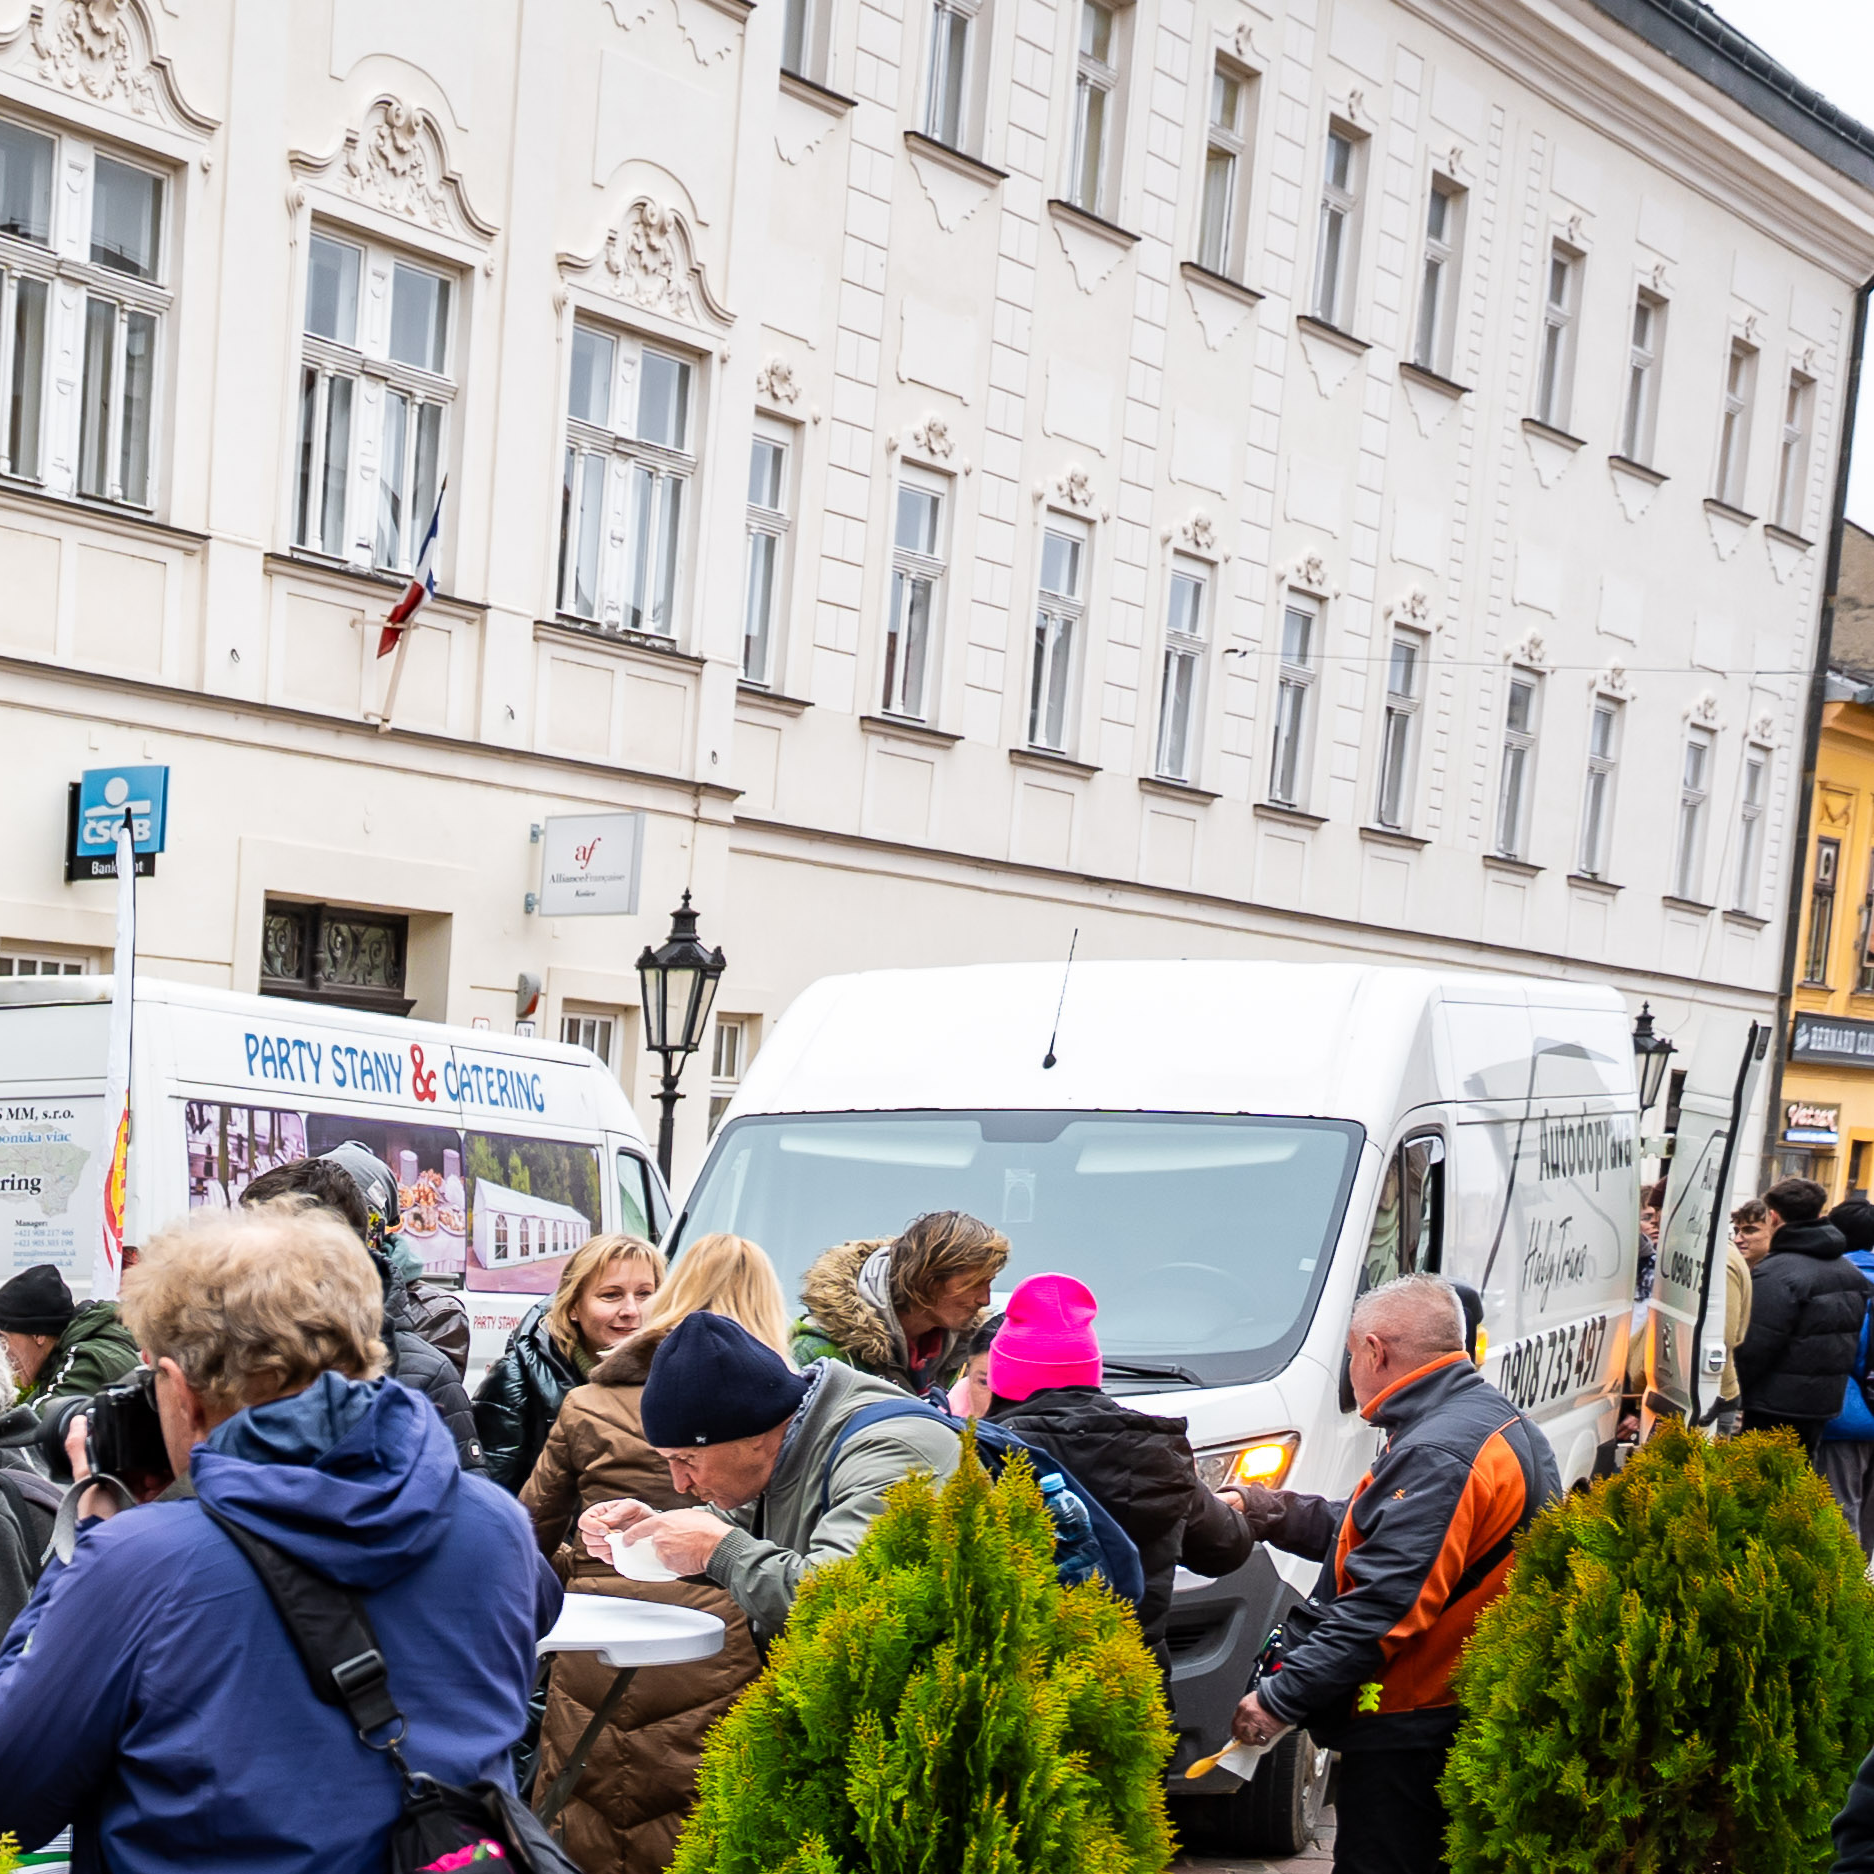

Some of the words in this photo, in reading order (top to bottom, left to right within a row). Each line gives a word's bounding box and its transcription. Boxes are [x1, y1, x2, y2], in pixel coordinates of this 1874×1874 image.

[244, 1033, 322, 1084] PARTY
[331, 1044, 402, 1094] STANY
[410, 1043, 437, 1103] &
[444, 1060, 545, 1113] CATERING
[6, 1107, 39, 1122] MM,
[41, 1109, 74, 1120] s.r.o.
[45, 1130, 72, 1142] viac
[1539, 1102, 1633, 1192] Autodoprava
[1500, 1335, 1543, 1409] 0908
[1541, 1325, 1576, 1403] 735
[1576, 1315, 1607, 1388] 497
